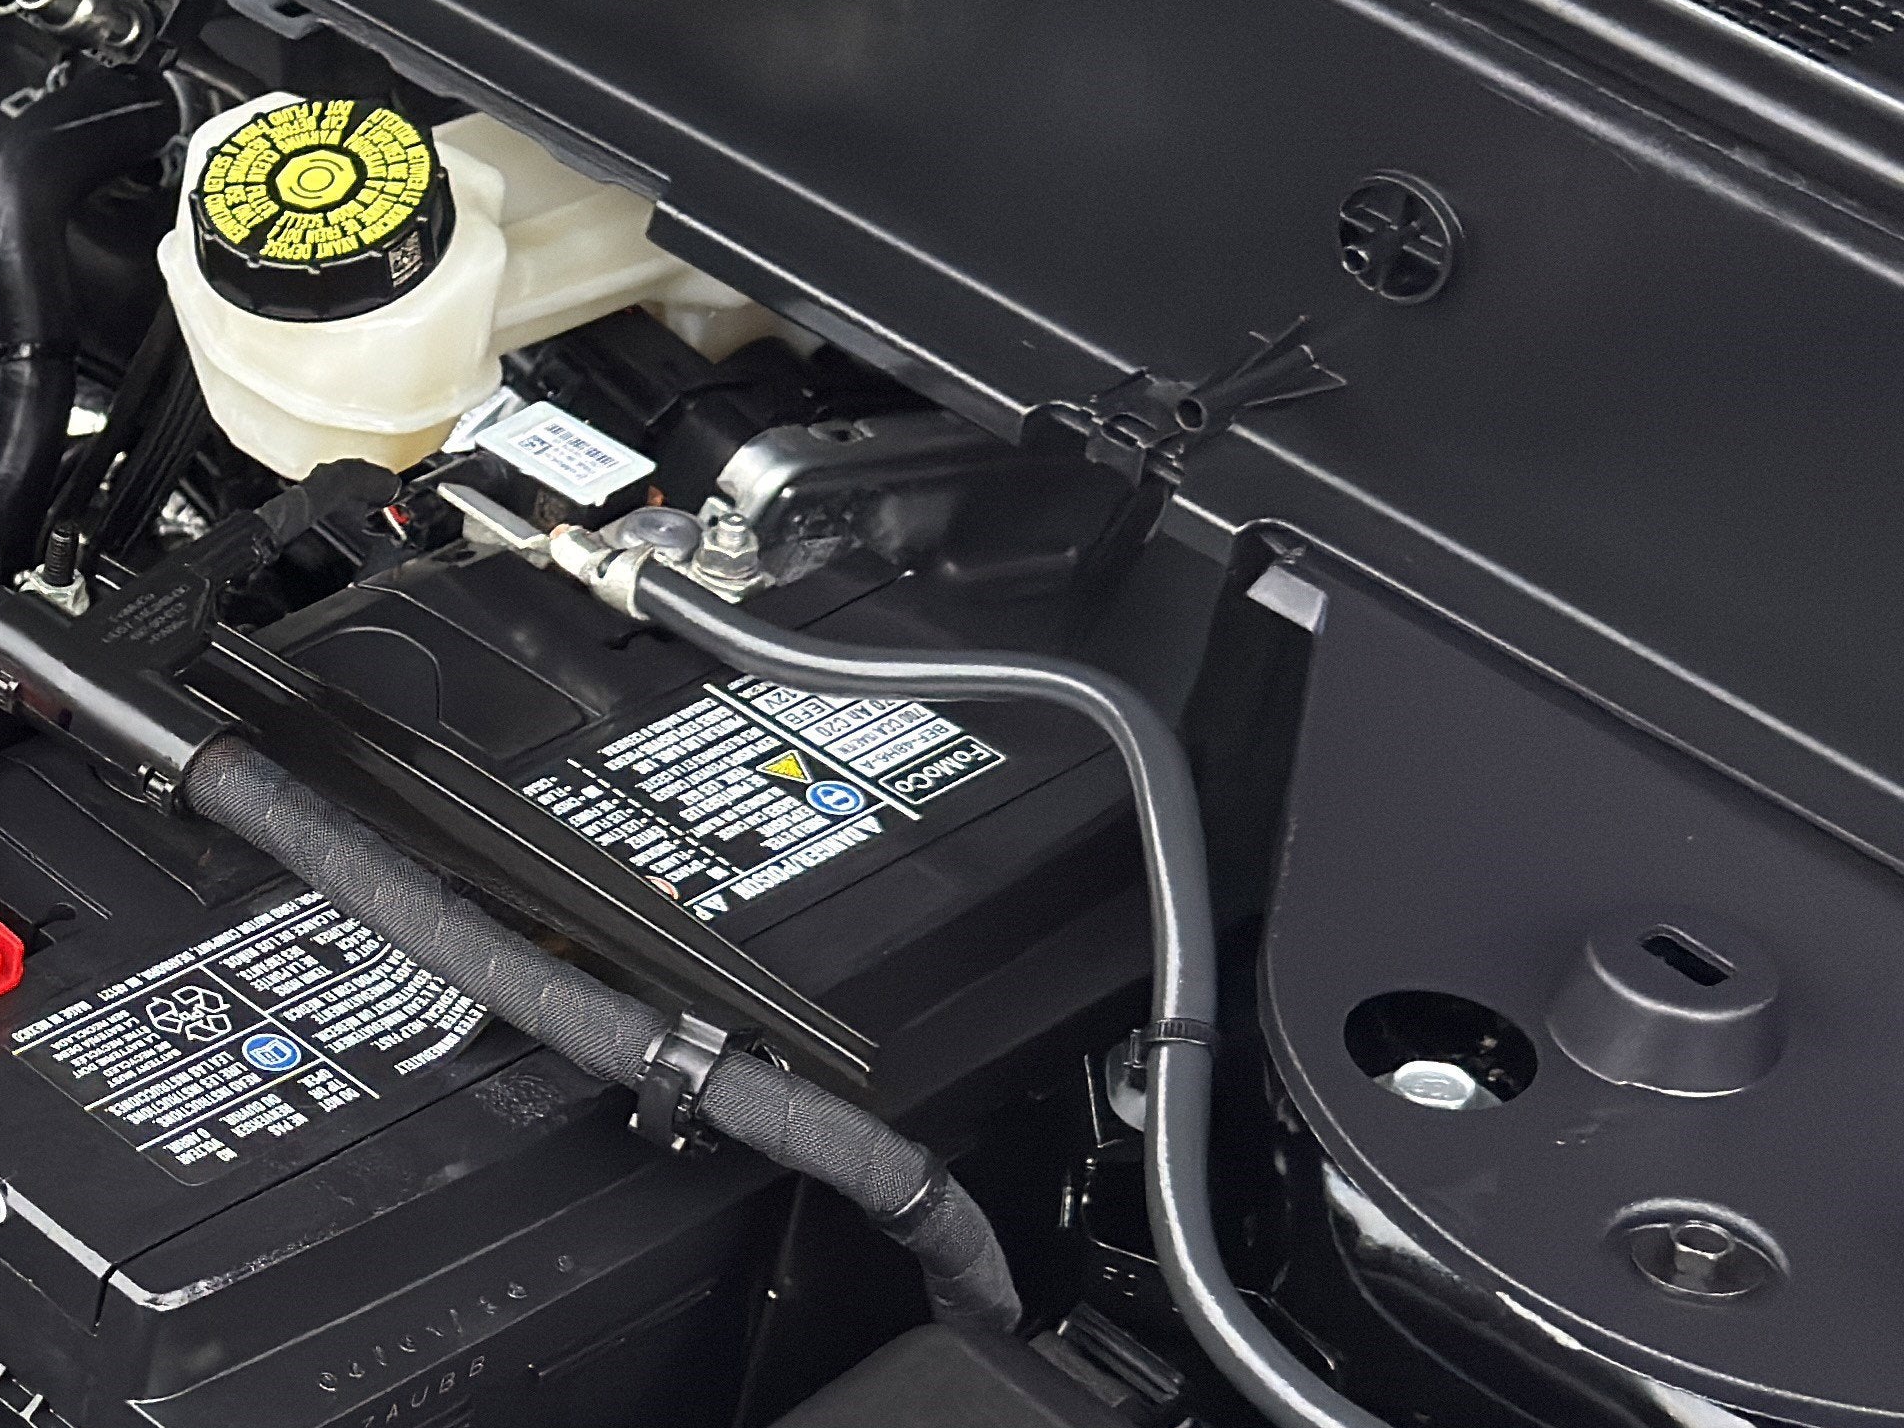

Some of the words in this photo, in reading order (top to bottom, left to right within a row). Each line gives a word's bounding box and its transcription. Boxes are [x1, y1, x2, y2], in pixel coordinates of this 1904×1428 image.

[760, 688, 799, 709] 12V
[812, 716, 854, 737] C20
[895, 744, 991, 792] FoMoCo
[730, 826, 870, 900] DANGER/POISON
[270, 901, 300, 918] FORD
[236, 913, 275, 934] MOTOR
[290, 909, 340, 936] ALCANCE
[255, 937, 281, 953] LOS
[275, 930, 296, 943] DE
[280, 945, 305, 960] DES
[355, 939, 379, 957] OUT
[299, 955, 319, 967] DE
[344, 952, 360, 963] OF
[286, 961, 306, 973] LA
[433, 996, 474, 1030] WATER.
[454, 1009, 483, 1035] EYES
[12, 1019, 53, 1042] MEXICO
[122, 1017, 140, 1028] LA
[399, 1019, 427, 1038] HELP
[50, 1020, 109, 1050] RECICLADA
[143, 1033, 160, 1043] LA
[103, 1048, 157, 1077] RECYCLED
[136, 1049, 182, 1074] BATTERY
[208, 1051, 234, 1067] LEA
[188, 1061, 214, 1077] LAS
[218, 1062, 248, 1080] LIRE
[199, 1073, 224, 1089] LES
[228, 1072, 262, 1092] READ
[326, 1079, 347, 1092] TIP
[339, 1088, 360, 1101] DO
[267, 1120, 294, 1136] PAS
